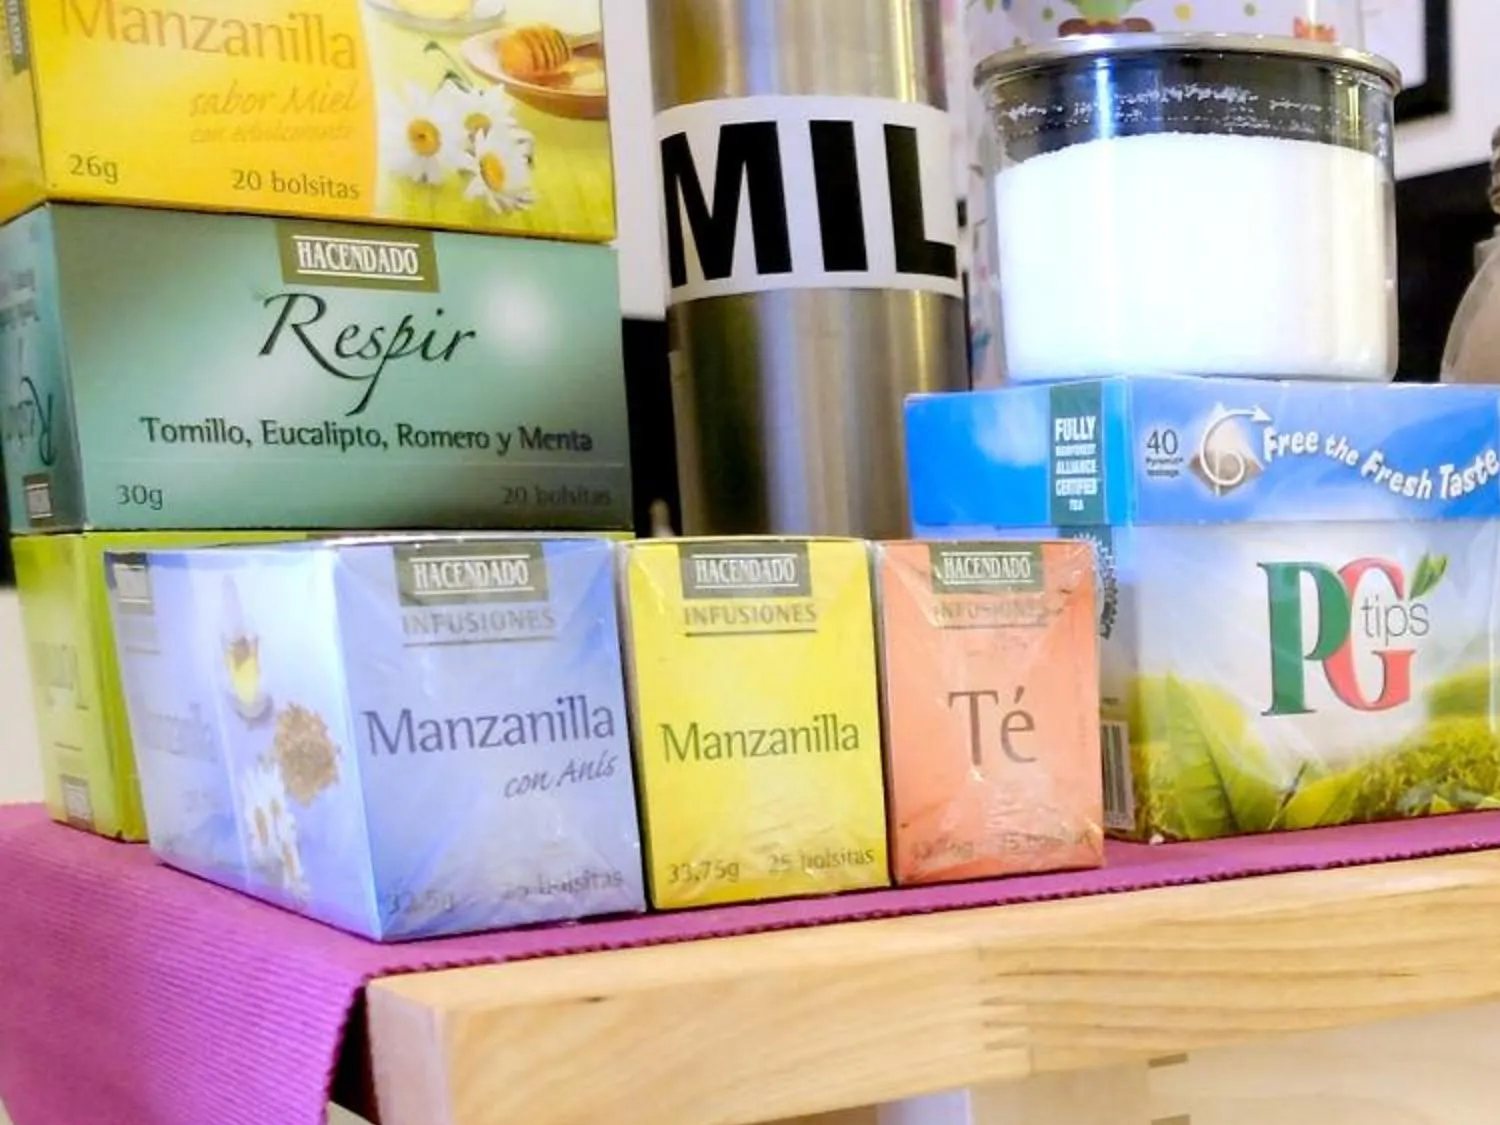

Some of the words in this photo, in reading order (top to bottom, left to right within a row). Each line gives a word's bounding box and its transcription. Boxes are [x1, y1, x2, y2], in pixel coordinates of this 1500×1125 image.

[60, 0, 357, 70] Manzanilla
[189, 79, 276, 118] sabor
[280, 78, 359, 115] Miel
[69, 153, 118, 185] 26g
[230, 168, 262, 191] 20
[271, 169, 359, 200] bolsitas
[297, 238, 419, 275] HACENDADO
[258, 292, 476, 417] Respir
[140, 416, 252, 448] Tomillo,
[262, 419, 389, 452] Eucalipto,
[397, 423, 490, 450] Romero
[496, 431, 512, 454] y
[518, 426, 594, 452] Menta
[1055, 415, 1097, 442] FULLY
[1147, 429, 1178, 455] 40
[1263, 427, 1320, 462] Free
[1325, 435, 1360, 466] the
[1361, 450, 1433, 499] Fresh
[1439, 449, 1500, 500] Taste
[116, 484, 163, 510] 30g
[413, 558, 531, 590] HACENDADO
[695, 554, 798, 584] HACENDADO
[943, 556, 1031, 579] HACENDADO
[402, 605, 558, 635] INFUSIONES
[684, 601, 817, 627] INFUSIONES
[1360, 595, 1430, 646] tips
[1256, 557, 1416, 717] PG
[364, 695, 616, 757] Manzanilla
[660, 713, 861, 766] Manzanilla
[948, 686, 1037, 767] Té
[503, 768, 550, 799] con
[801, 848, 876, 870] bolsitas
